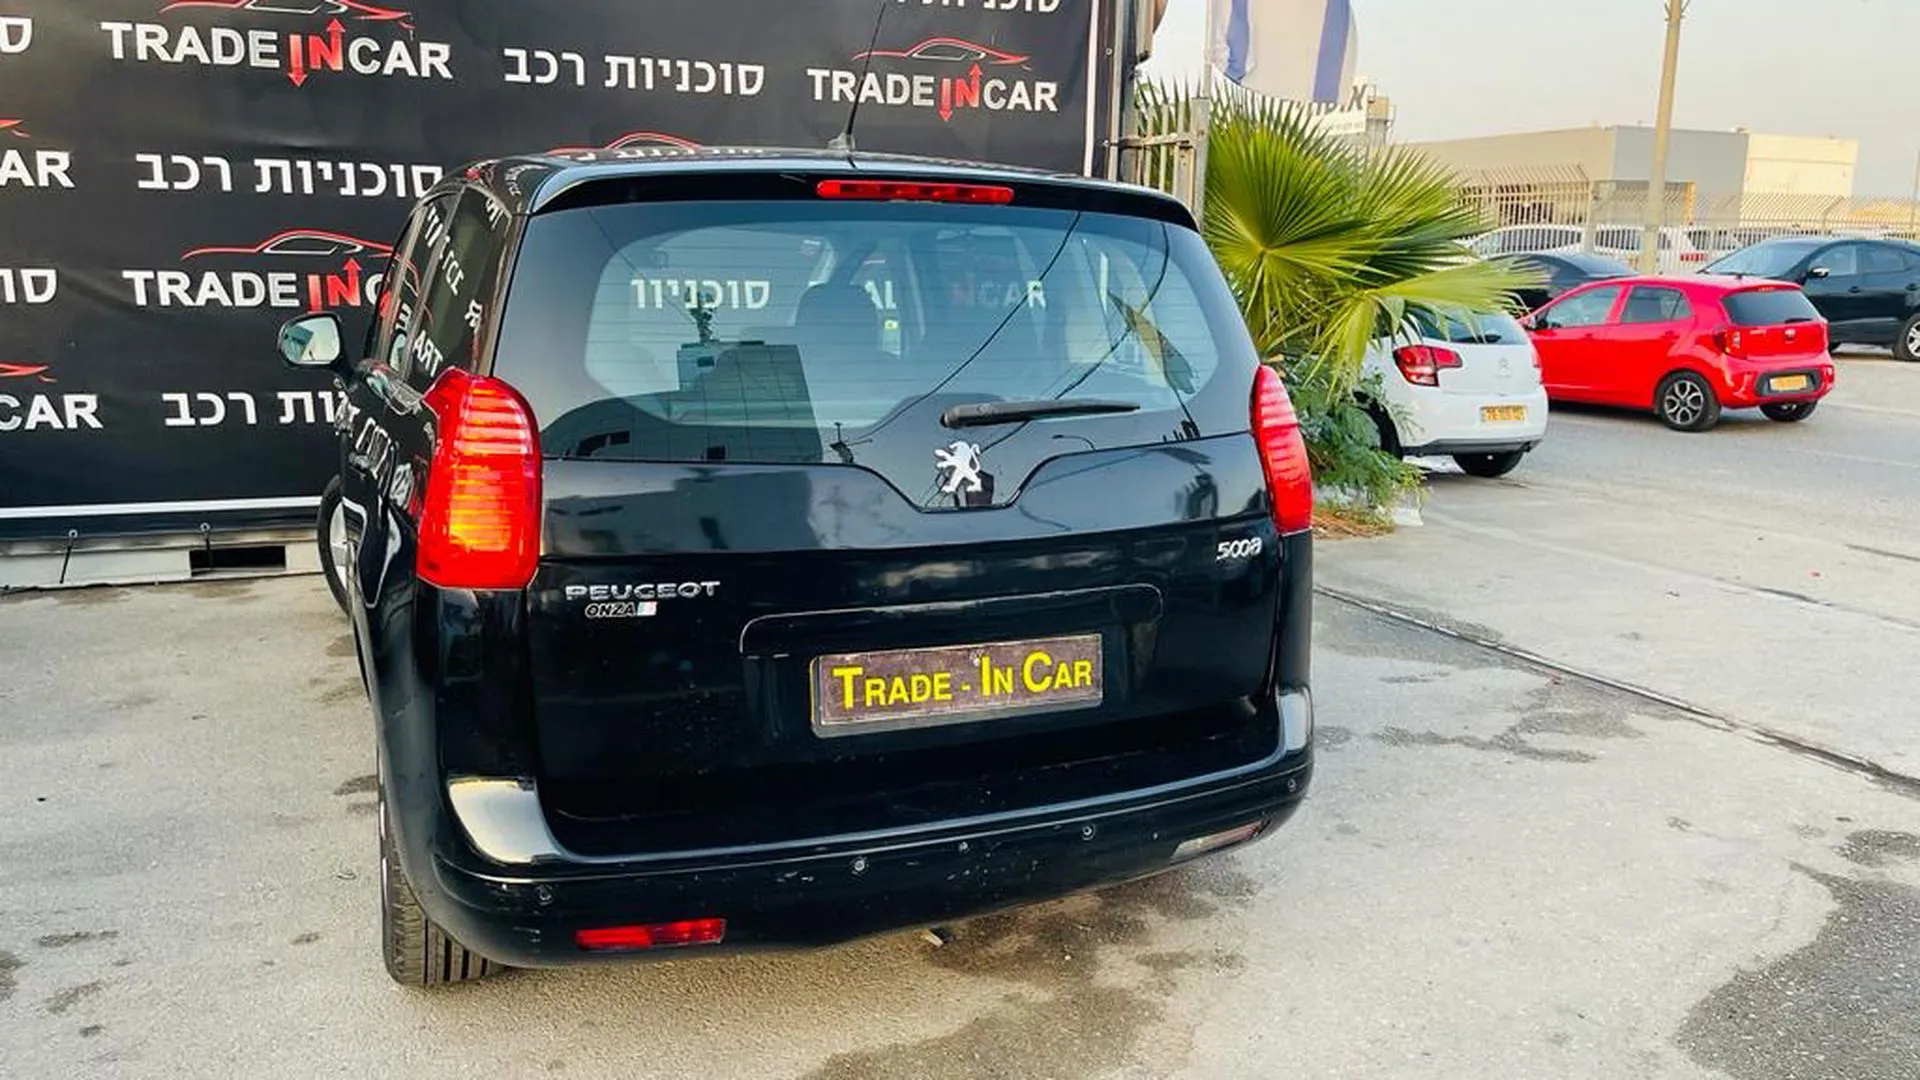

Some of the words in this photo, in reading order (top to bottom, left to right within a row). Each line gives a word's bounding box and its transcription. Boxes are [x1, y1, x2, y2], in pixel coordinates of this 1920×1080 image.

[101, 22, 280, 69] TRADE
[288, 20, 345, 87] IN
[349, 37, 453, 79] CAR
[504, 48, 585, 86] רכב
[604, 55, 765, 96] סוכניות
[806, 68, 934, 106] TRADE
[939, 63, 982, 122] IN
[983, 80, 1058, 112] CAR
[0, 149, 76, 188] AR
[136, 154, 232, 192] רכב
[254, 158, 444, 199] סוכניות
[123, 270, 300, 307] TRADE
[307, 258, 361, 313] IN
[163, 393, 257, 426] רכב
[1216, 537, 1262, 560] 5008
[565, 581, 720, 600] PEUGEOT
[585, 602, 636, 618] ONZA
